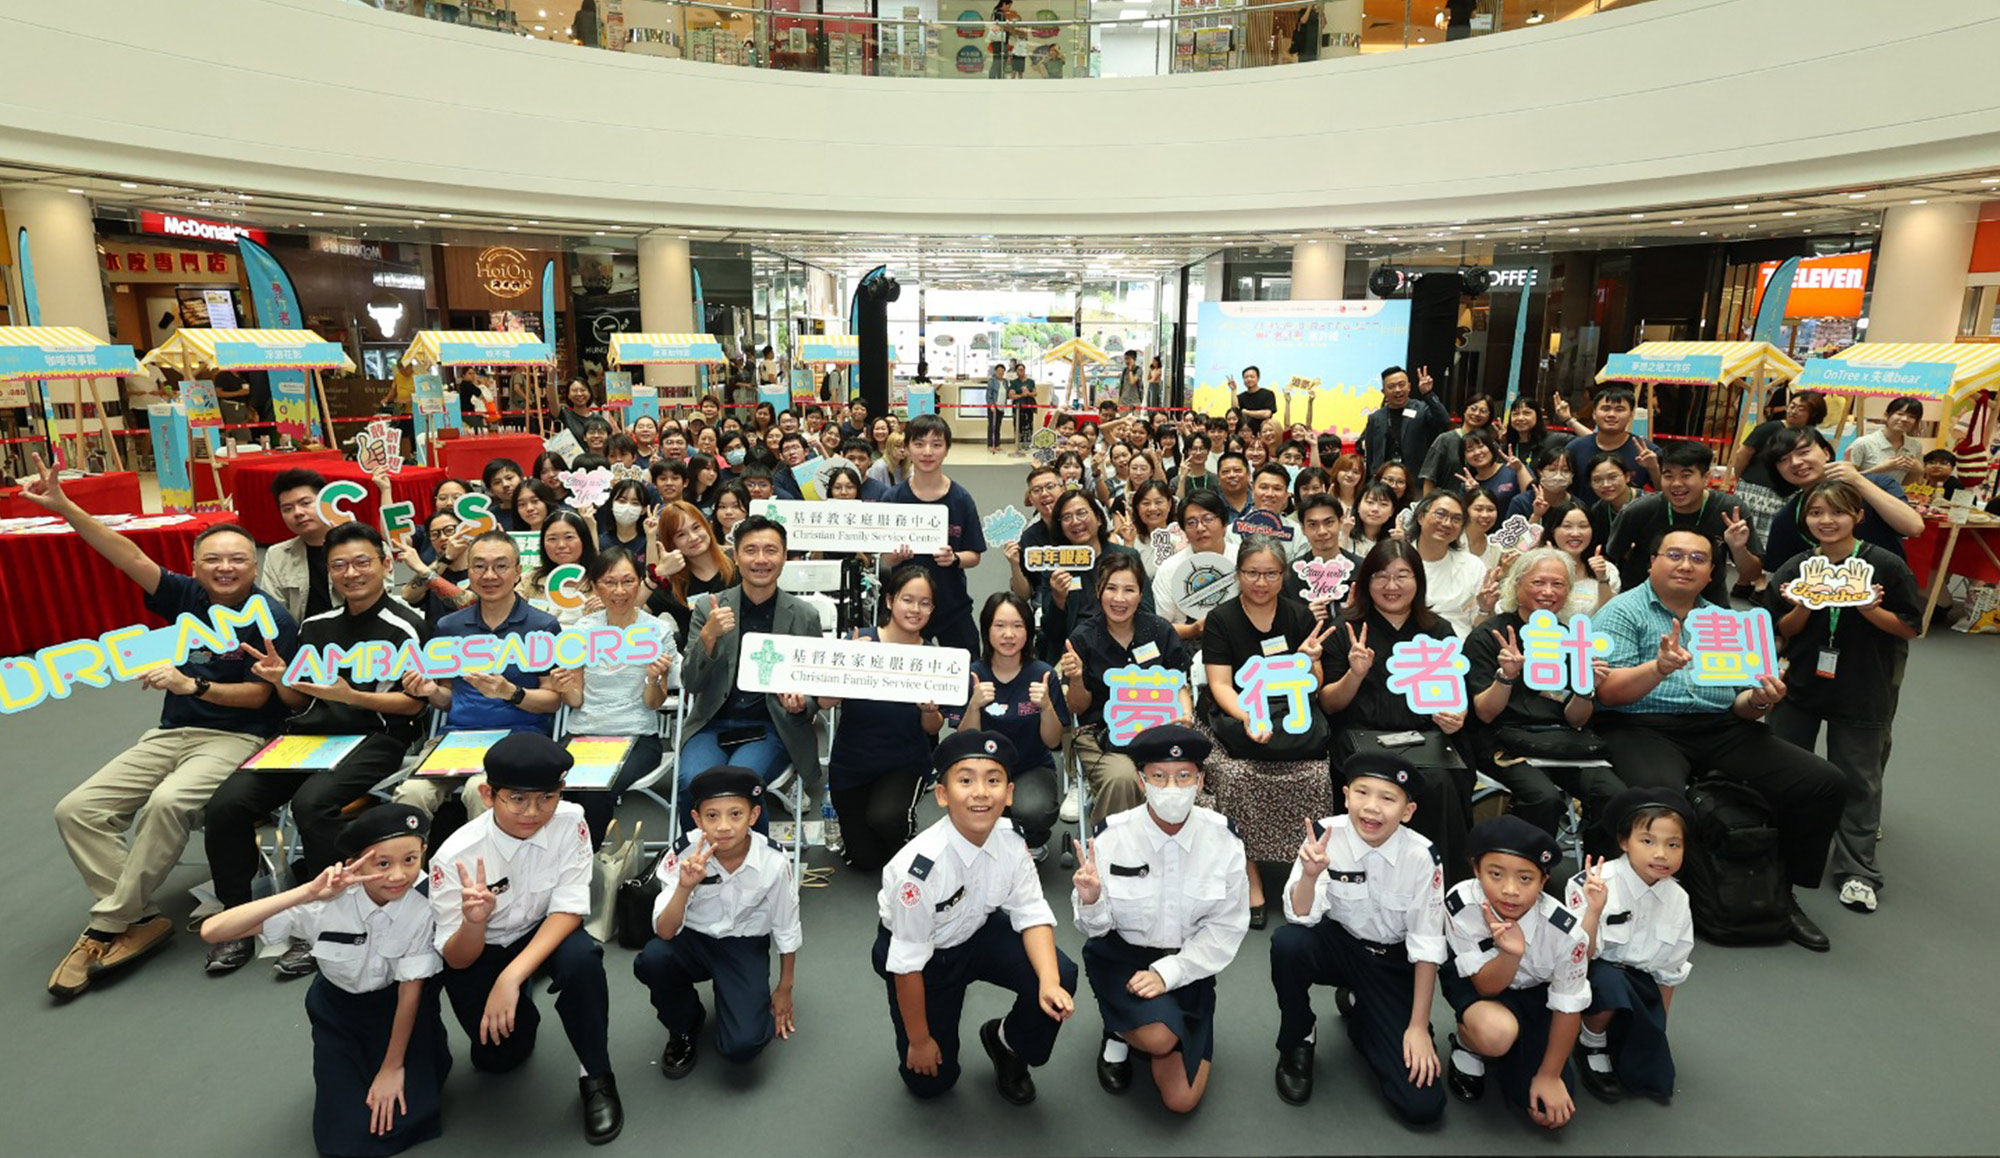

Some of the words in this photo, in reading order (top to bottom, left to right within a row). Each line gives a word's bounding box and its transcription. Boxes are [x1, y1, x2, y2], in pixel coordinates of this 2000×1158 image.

[1489, 269, 1539, 286] OFFEE
[1823, 369, 1860, 381] OnTree
[793, 511, 941, 529] 基督教家庭服務中心
[793, 529, 836, 541] Christian
[838, 530, 869, 542] Family
[872, 531, 905, 542] Service
[909, 533, 941, 543] Centre
[1028, 549, 1091, 566] 青年服務
[1301, 566, 1325, 580] Stay
[1326, 567, 1347, 579] with
[1311, 580, 1338, 597] You
[1791, 582, 1871, 606] Together
[0, 598, 274, 709] DREAM
[287, 627, 659, 683] AMBASSADORS
[793, 648, 962, 675] 基督教家庭服務中心
[791, 671, 840, 685] Christian
[843, 673, 880, 689] Family
[882, 676, 921, 690] Service
[925, 679, 961, 693] Centre
